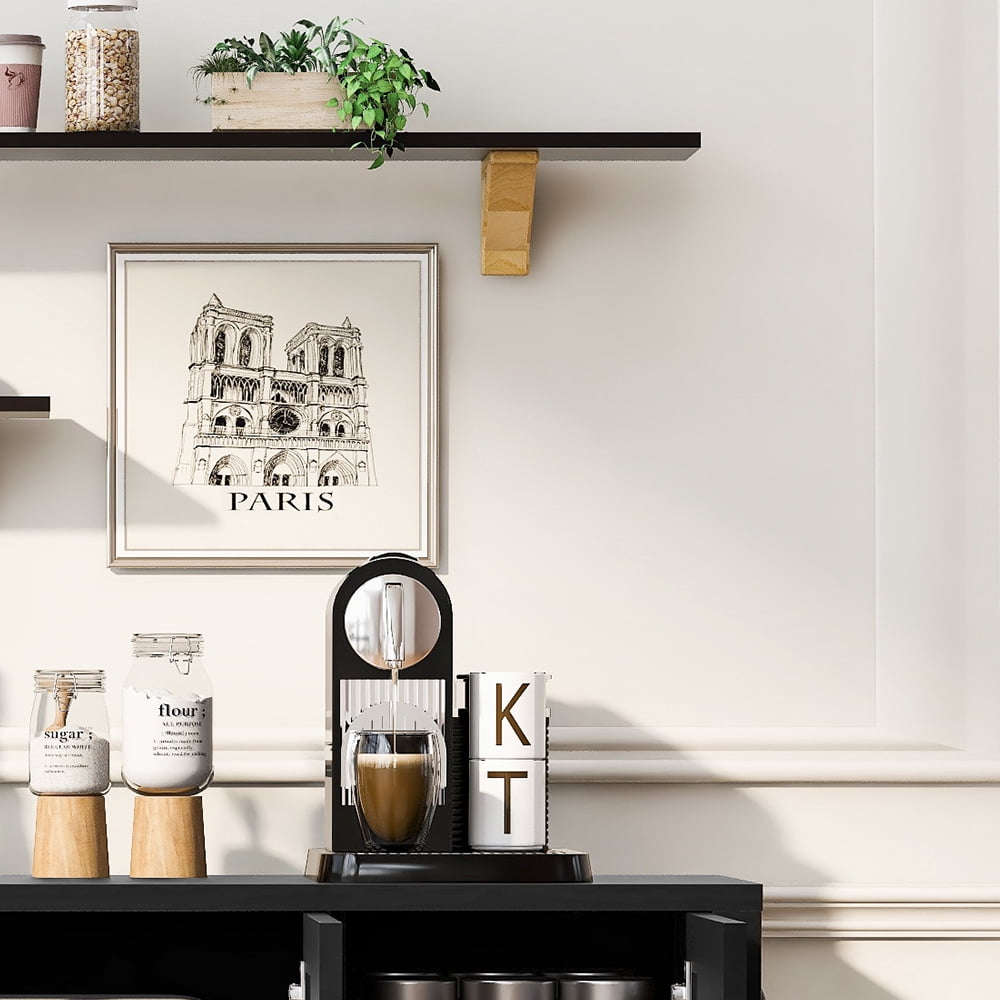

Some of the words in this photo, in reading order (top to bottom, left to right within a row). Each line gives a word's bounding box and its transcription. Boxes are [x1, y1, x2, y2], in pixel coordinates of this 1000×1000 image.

[228, 491, 334, 512] PARIS
[158, 703, 198, 718] flour
[495, 683, 531, 746] K
[44, 730, 84, 743] sugar
[487, 771, 528, 834] T
